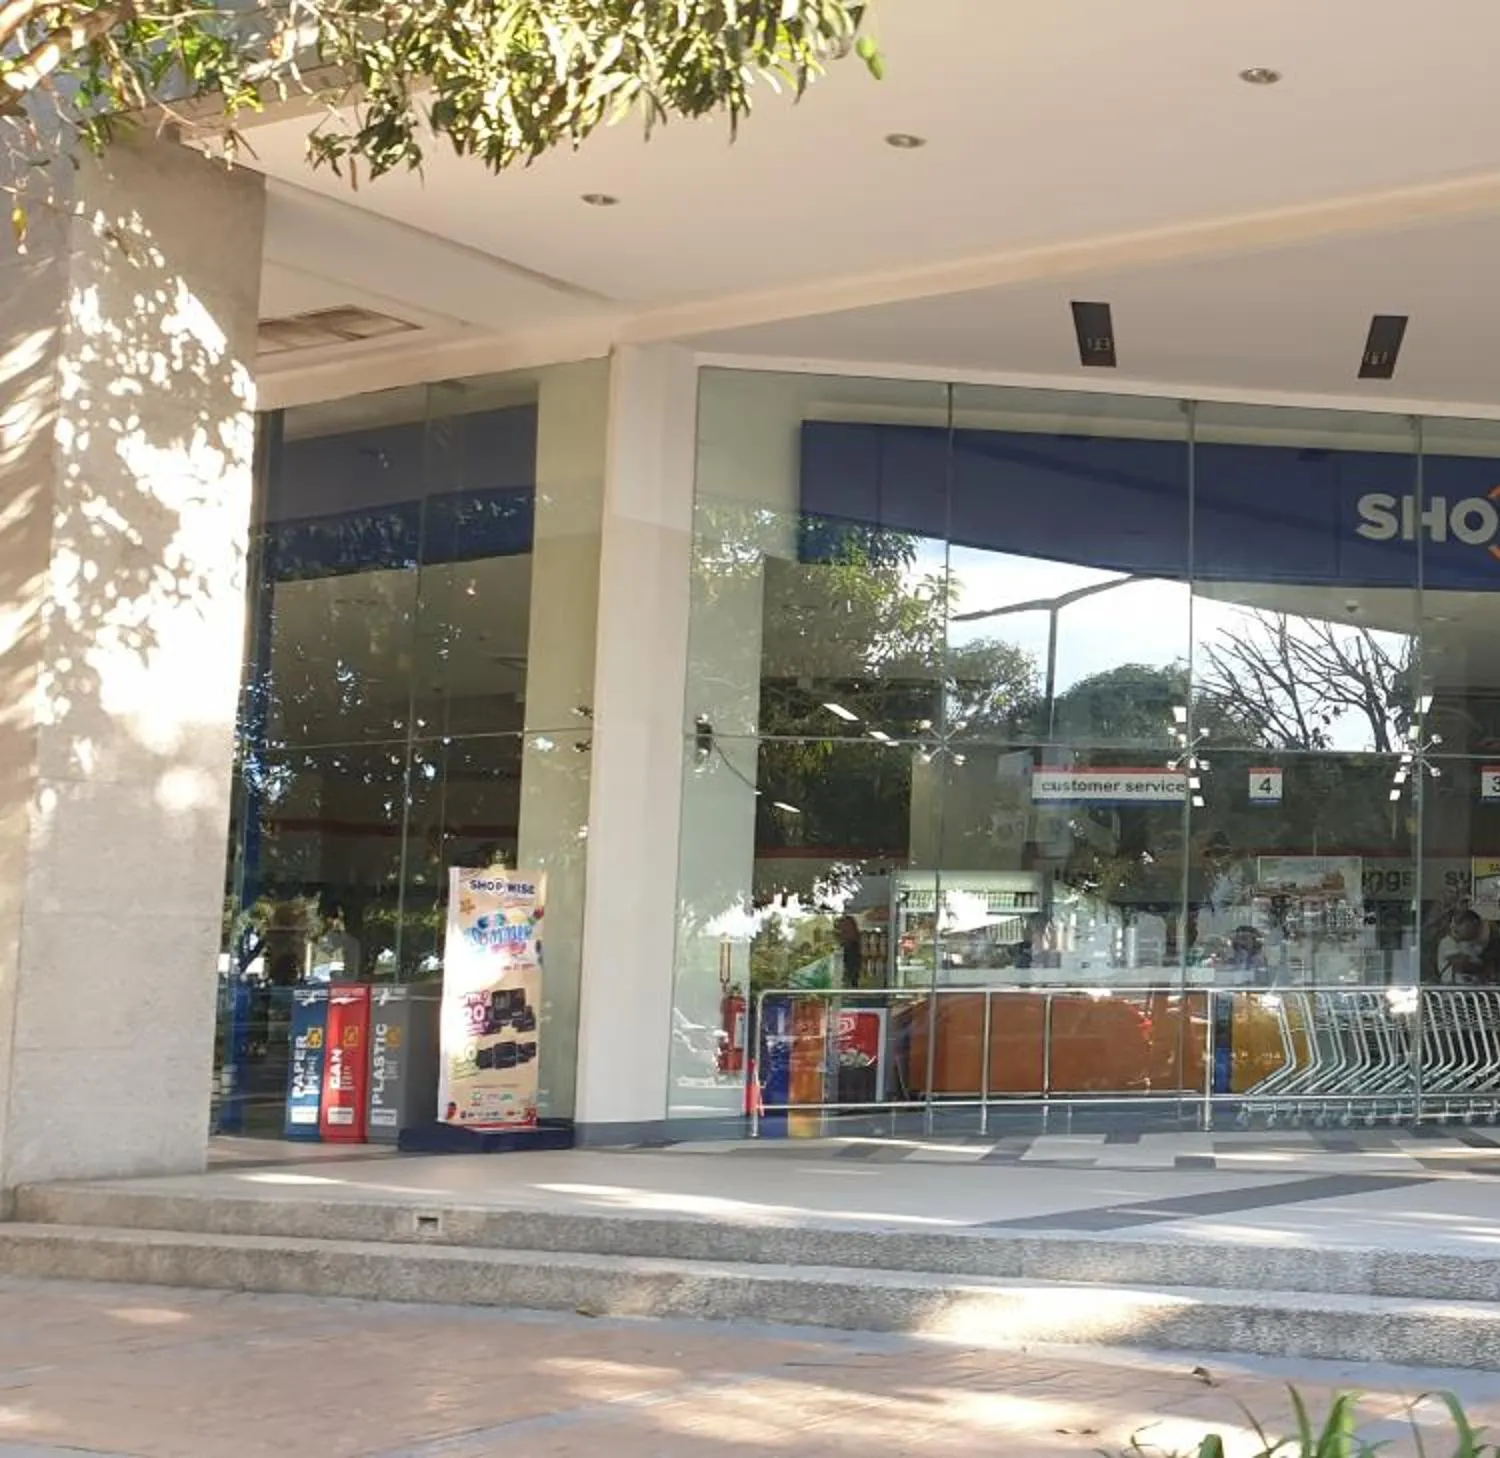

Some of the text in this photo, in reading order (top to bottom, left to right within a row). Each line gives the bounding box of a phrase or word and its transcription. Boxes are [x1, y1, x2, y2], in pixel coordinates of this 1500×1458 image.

[1041, 778, 1186, 794] customer service
[1258, 777, 1271, 795] 4
[291, 1034, 307, 1099] PAPER
[371, 1022, 389, 1105] PLASTIC
